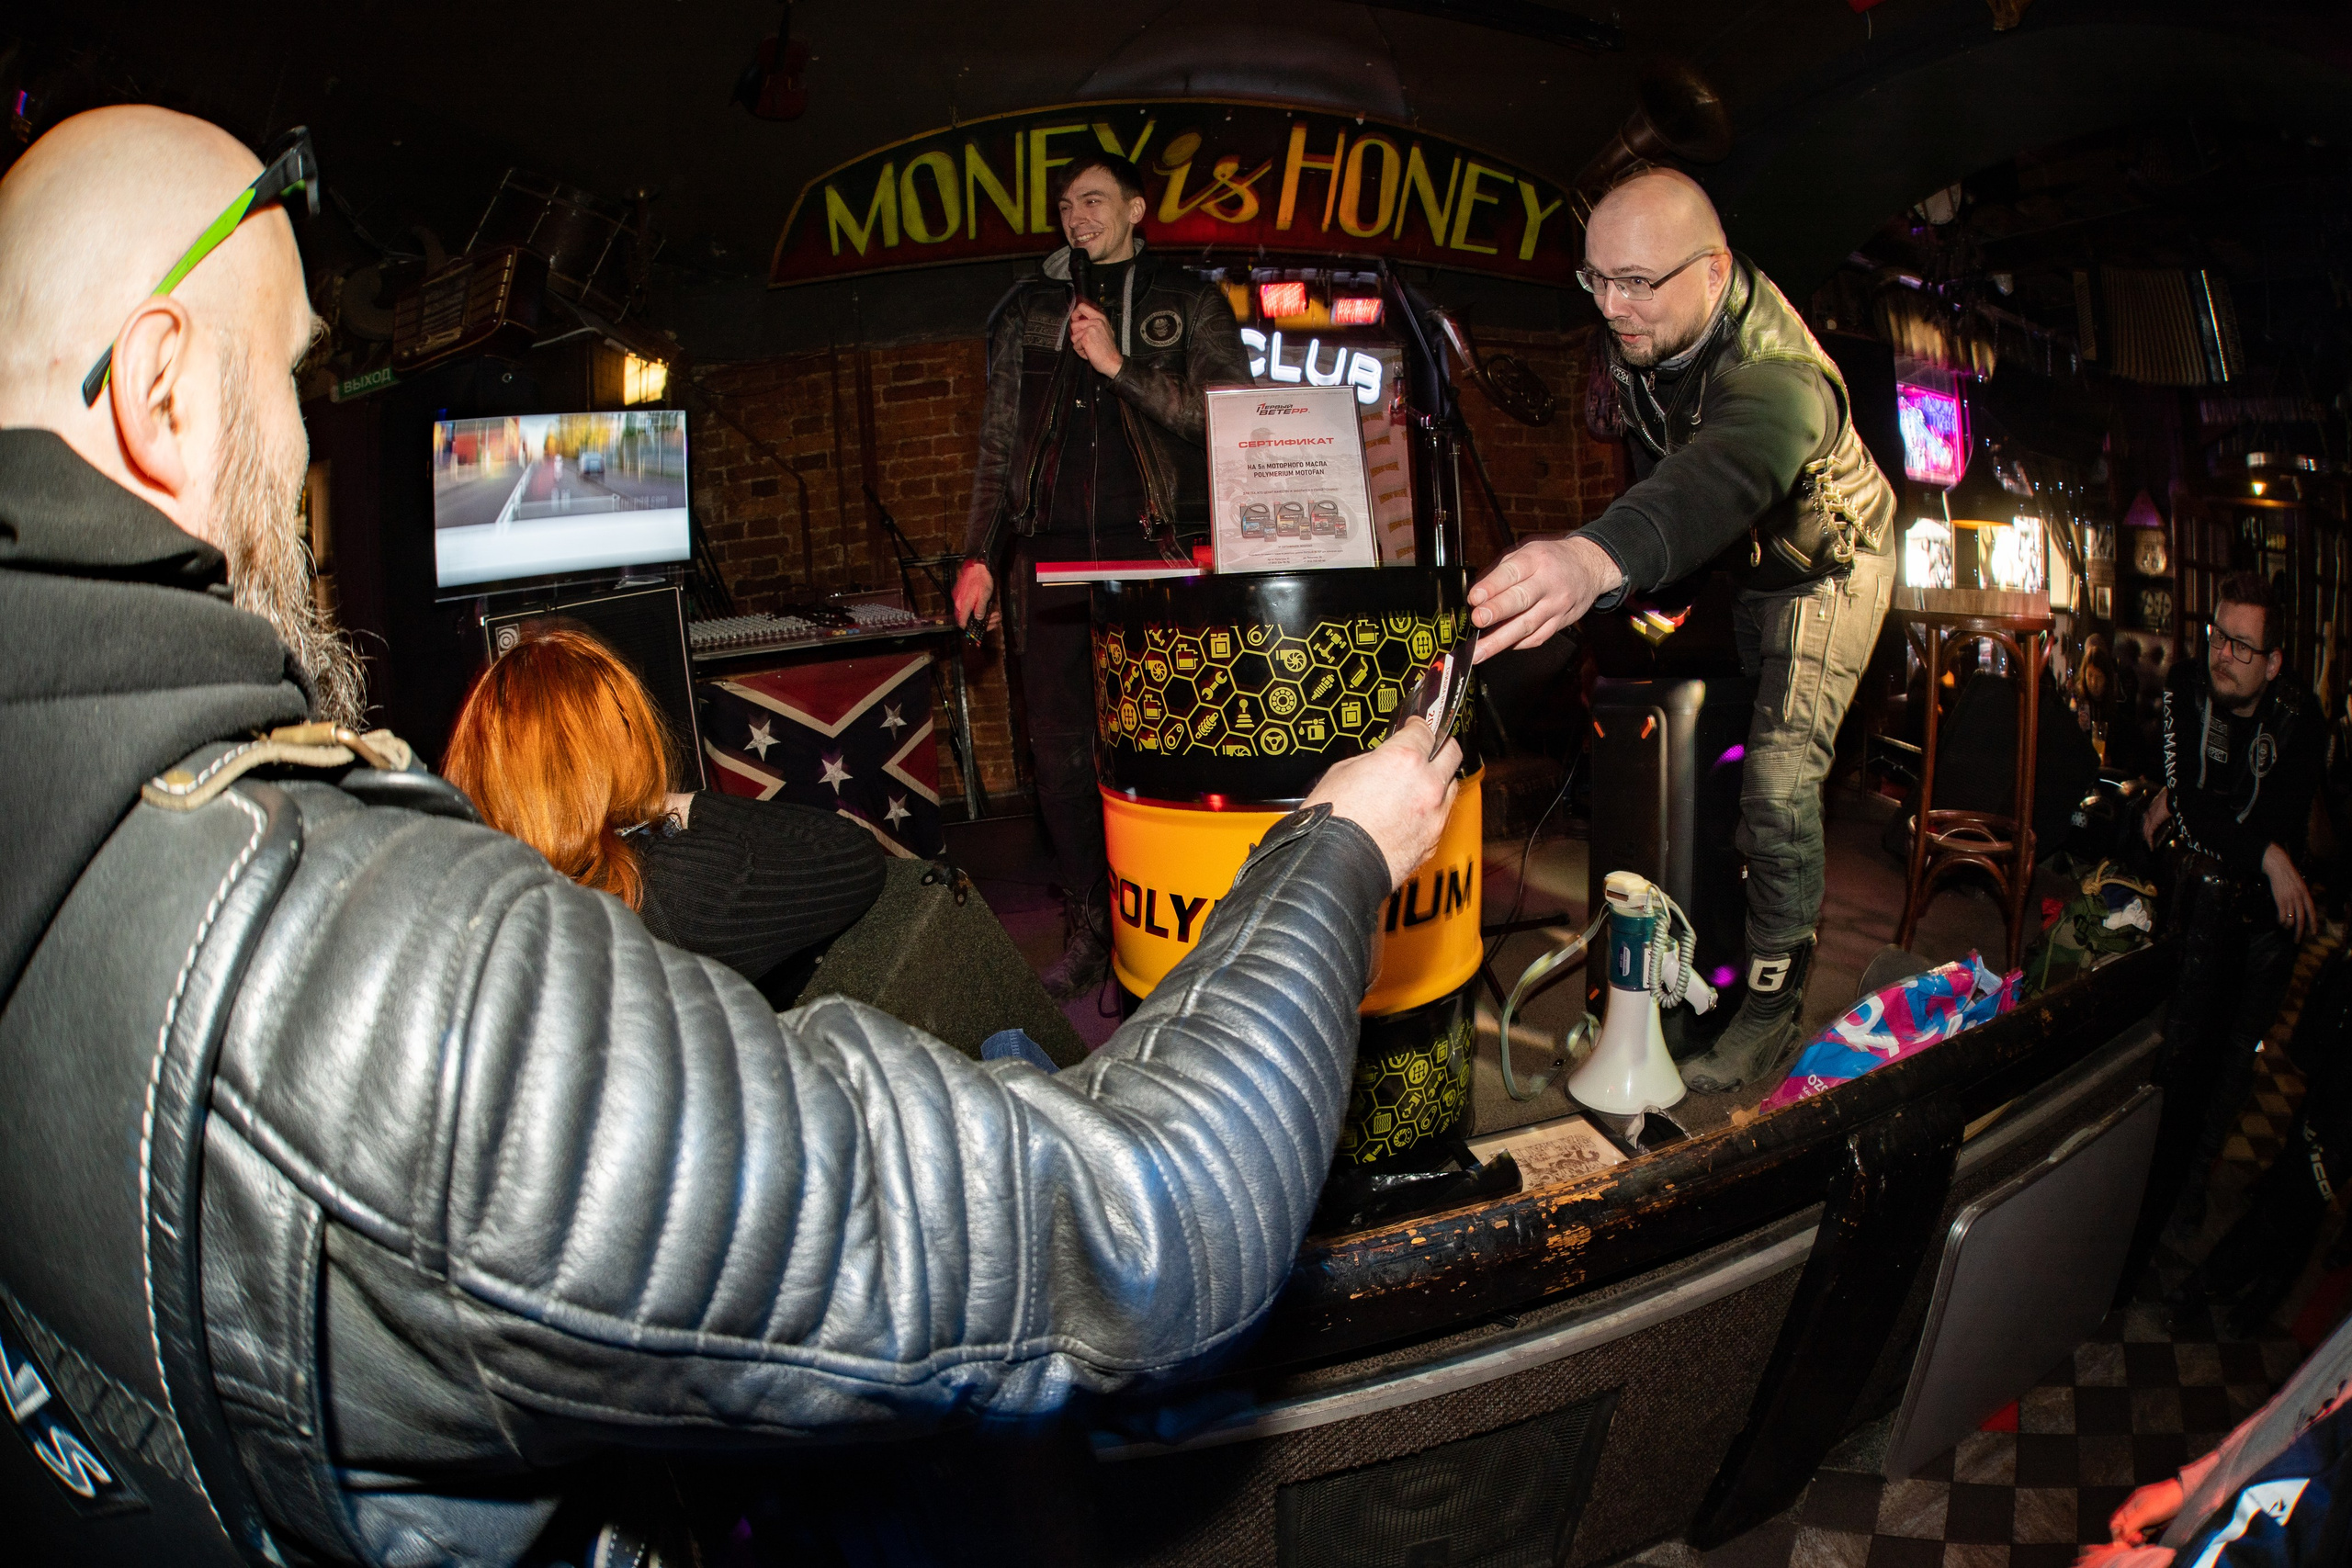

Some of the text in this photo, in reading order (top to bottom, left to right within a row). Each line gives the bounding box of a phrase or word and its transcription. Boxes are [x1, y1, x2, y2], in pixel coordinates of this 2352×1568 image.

[1153, 131, 1272, 224] is
[1276, 122, 1563, 261] HONEY
[344, 367, 391, 393] ВЫХОД
[1238, 437, 1334, 448] СЕРТИФИКАТ
[1253, 469, 1294, 478] POLYMERIUM
